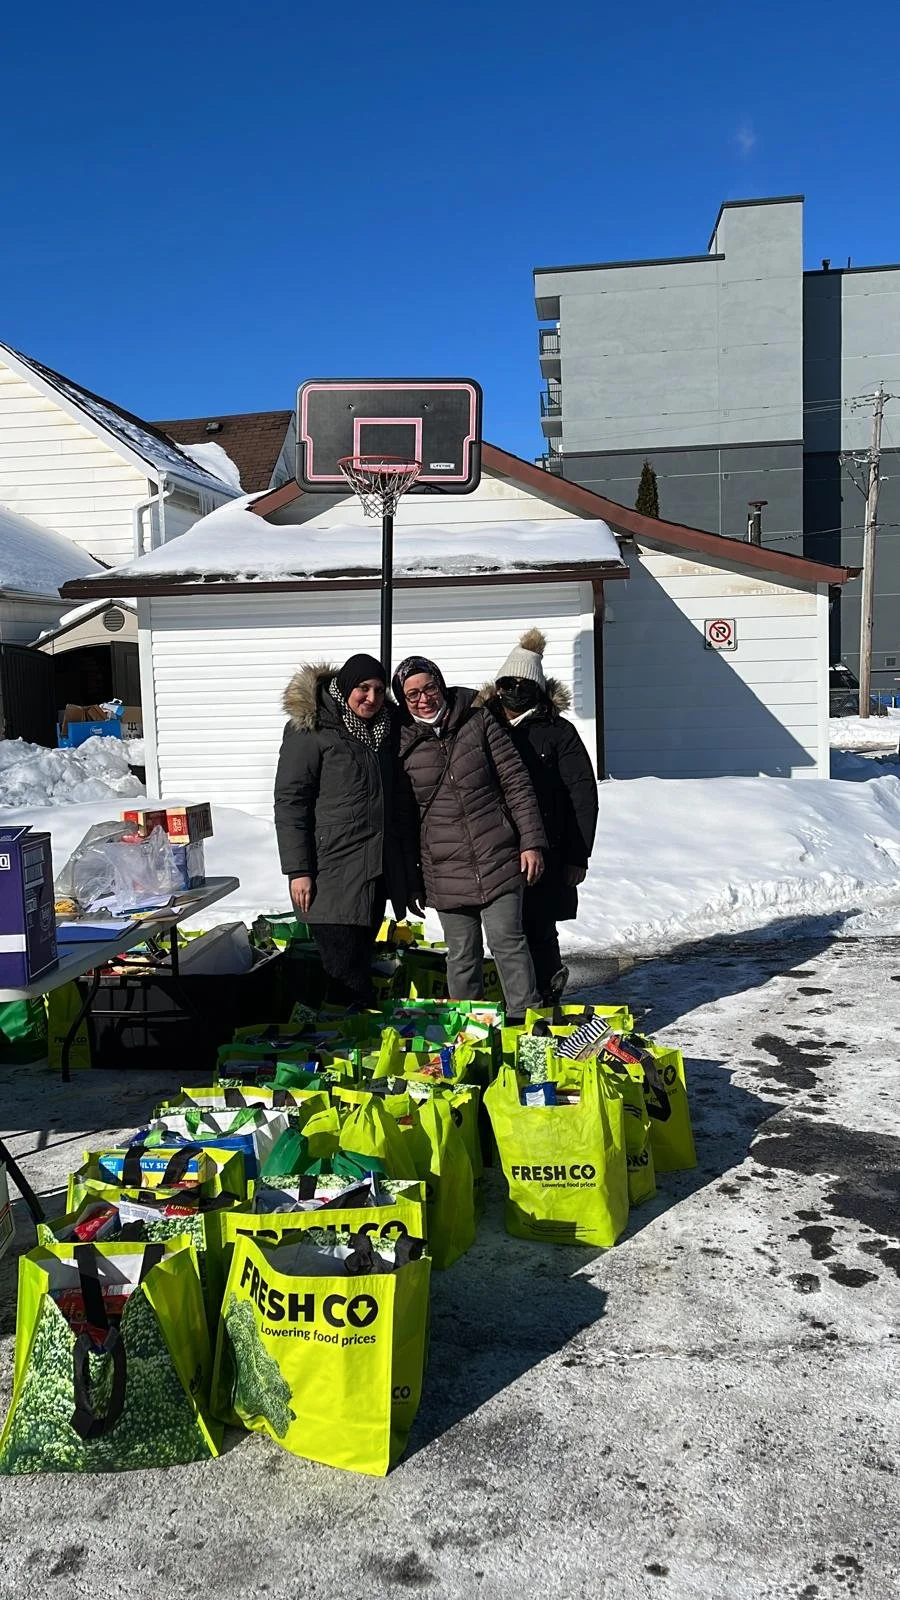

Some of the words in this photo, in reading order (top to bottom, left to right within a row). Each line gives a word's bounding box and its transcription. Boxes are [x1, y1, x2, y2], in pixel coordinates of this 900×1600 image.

[511, 1165, 566, 1181] FRESH
[569, 1164, 596, 1180] CO
[239, 1256, 315, 1322] FRESH
[322, 1293, 379, 1329] CO
[260, 1322, 310, 1341] Lowering
[313, 1329, 339, 1345] food
[341, 1334, 377, 1348] prices
